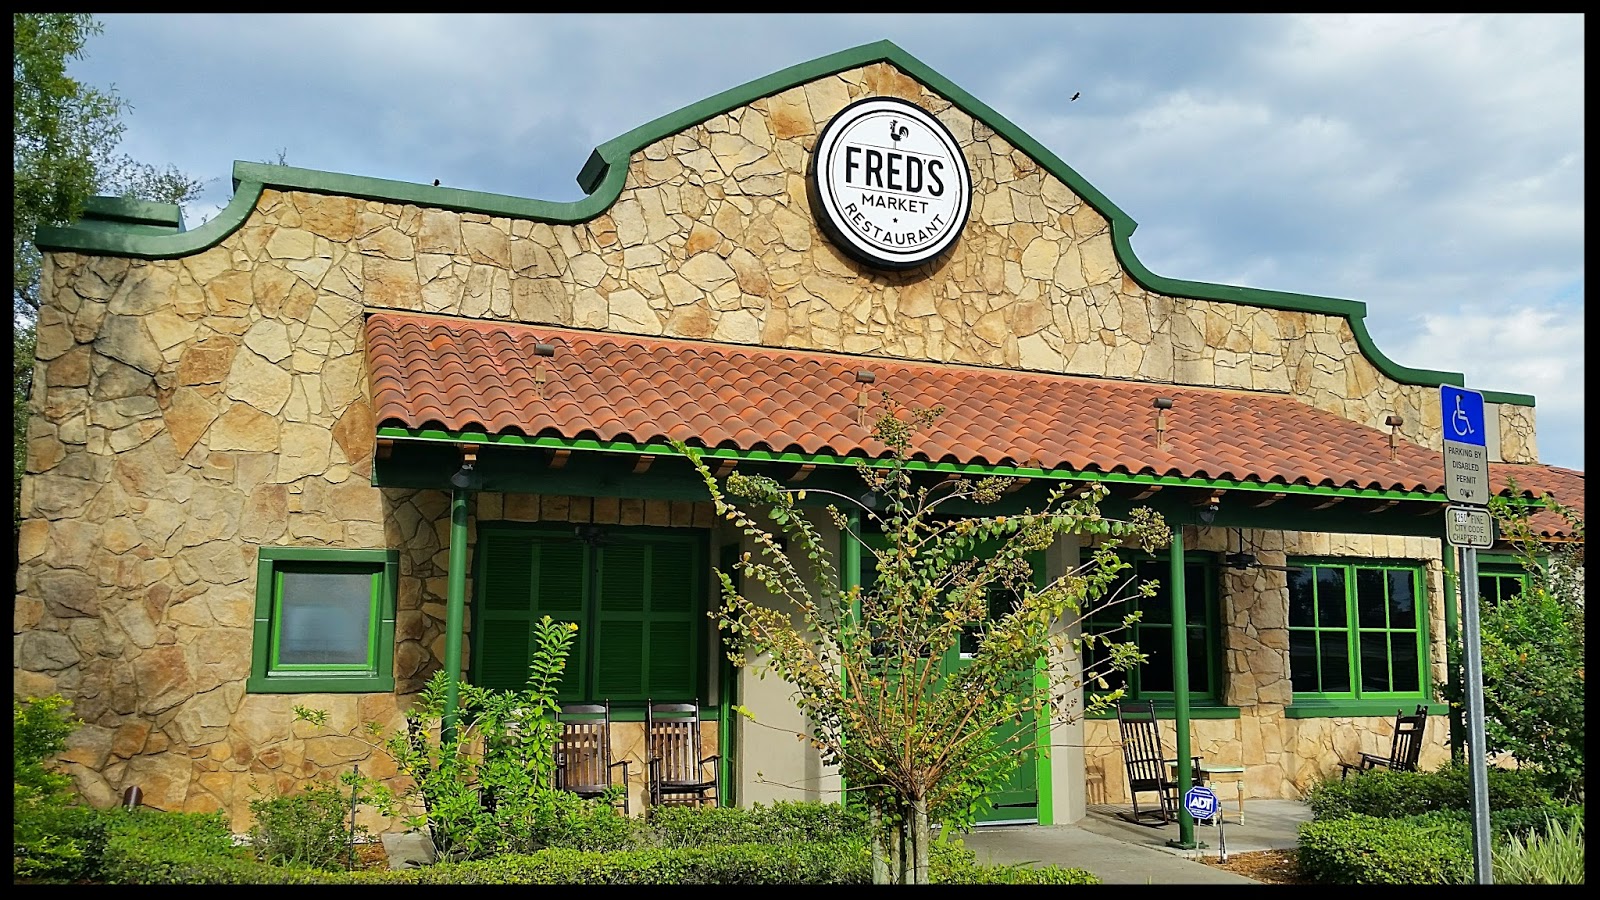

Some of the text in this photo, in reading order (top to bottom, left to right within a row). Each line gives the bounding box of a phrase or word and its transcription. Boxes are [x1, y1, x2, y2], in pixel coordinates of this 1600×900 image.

[846, 146, 944, 197] FRED'S
[862, 193, 928, 214] MARKET
[845, 203, 945, 245] RESTAURANT
[1448, 447, 1482, 459] PARKING BY
[1452, 461, 1479, 471] DISABLED
[1456, 474, 1476, 484] PERMIT
[1471, 515, 1484, 525] FINE
[1455, 524, 1484, 534] CITY CODE
[1453, 533, 1478, 542] CHAPTER
[1190, 796, 1212, 810] ADT
